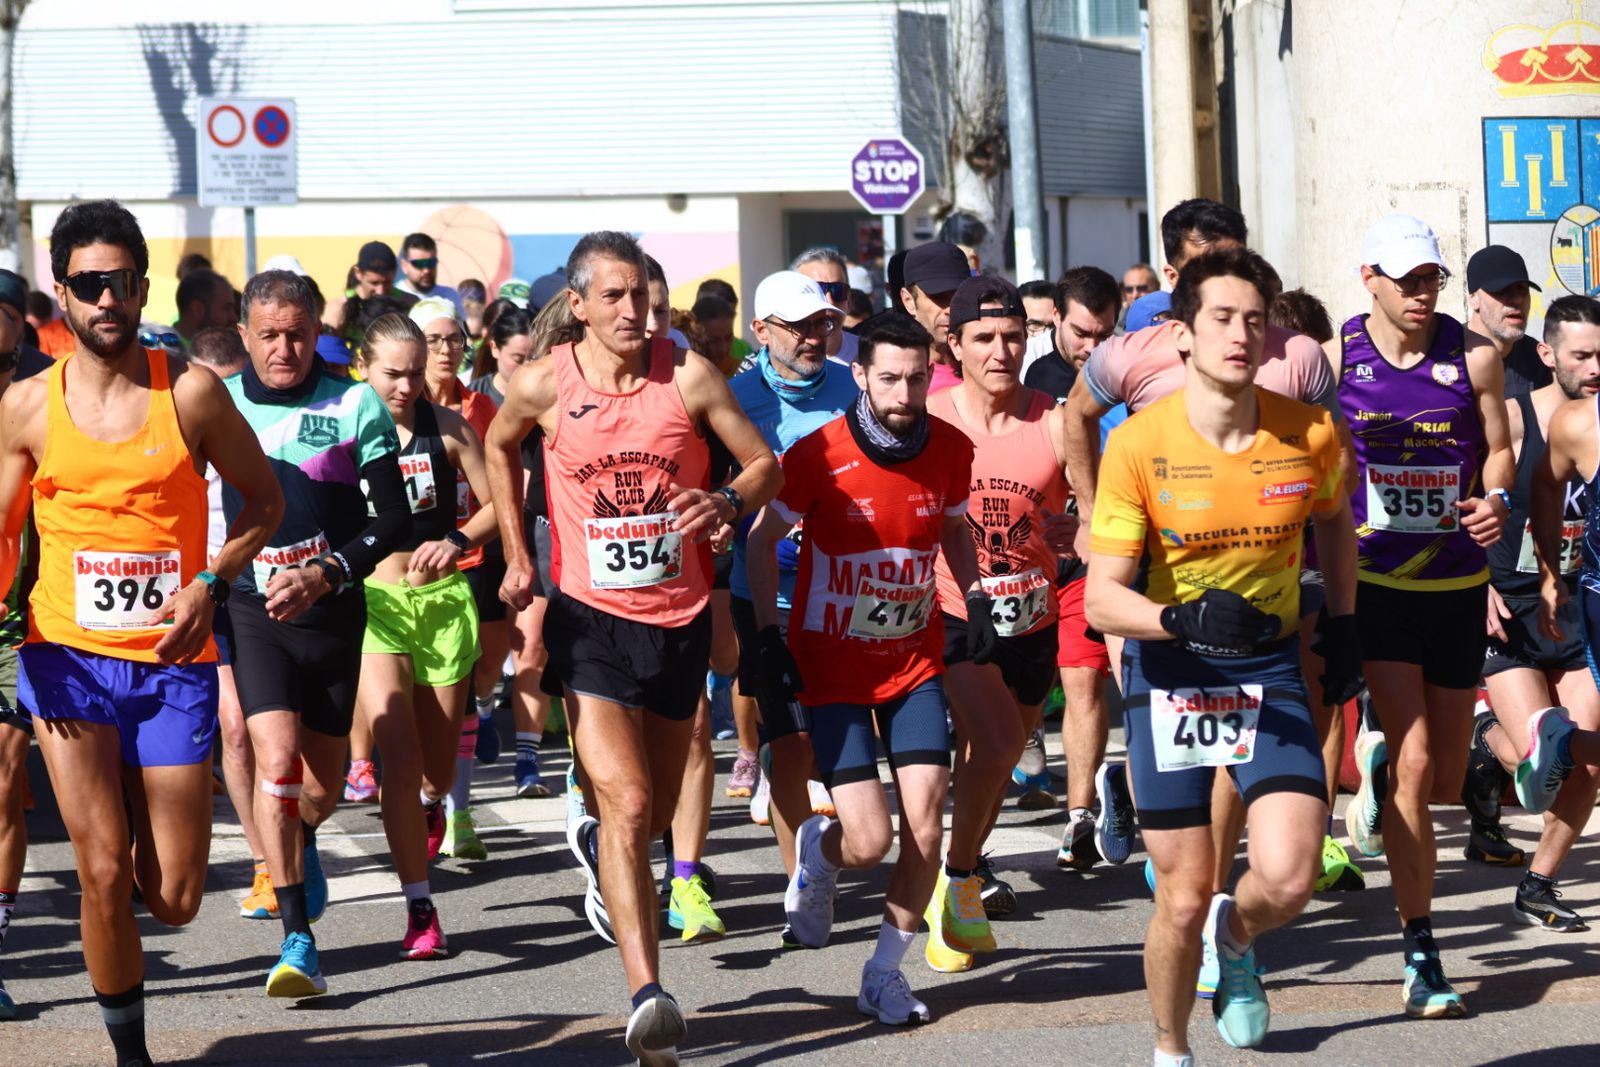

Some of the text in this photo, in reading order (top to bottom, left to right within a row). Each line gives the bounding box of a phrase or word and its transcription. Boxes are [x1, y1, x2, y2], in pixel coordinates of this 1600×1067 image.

[855, 160, 918, 182] STOP
[1413, 421, 1452, 433] PRIM
[574, 451, 680, 484] BAR LA ESCAPADA
[1369, 468, 1457, 487] bedunia
[614, 470, 643, 488] RUN
[616, 488, 646, 506] CLUB
[982, 497, 1010, 512] RUN
[1383, 488, 1445, 517] 355
[588, 517, 680, 540] bedunia
[982, 513, 1010, 528] CLUB
[1184, 527, 1249, 542] ESCUELA
[605, 536, 670, 572] 354
[77, 556, 178, 576] bedunia
[828, 553, 934, 596] MARAT
[94, 577, 163, 612] 396
[861, 581, 930, 602] bedun
[982, 574, 1046, 597] edunia
[1170, 691, 1259, 713] edunia
[1174, 713, 1244, 749] 403
